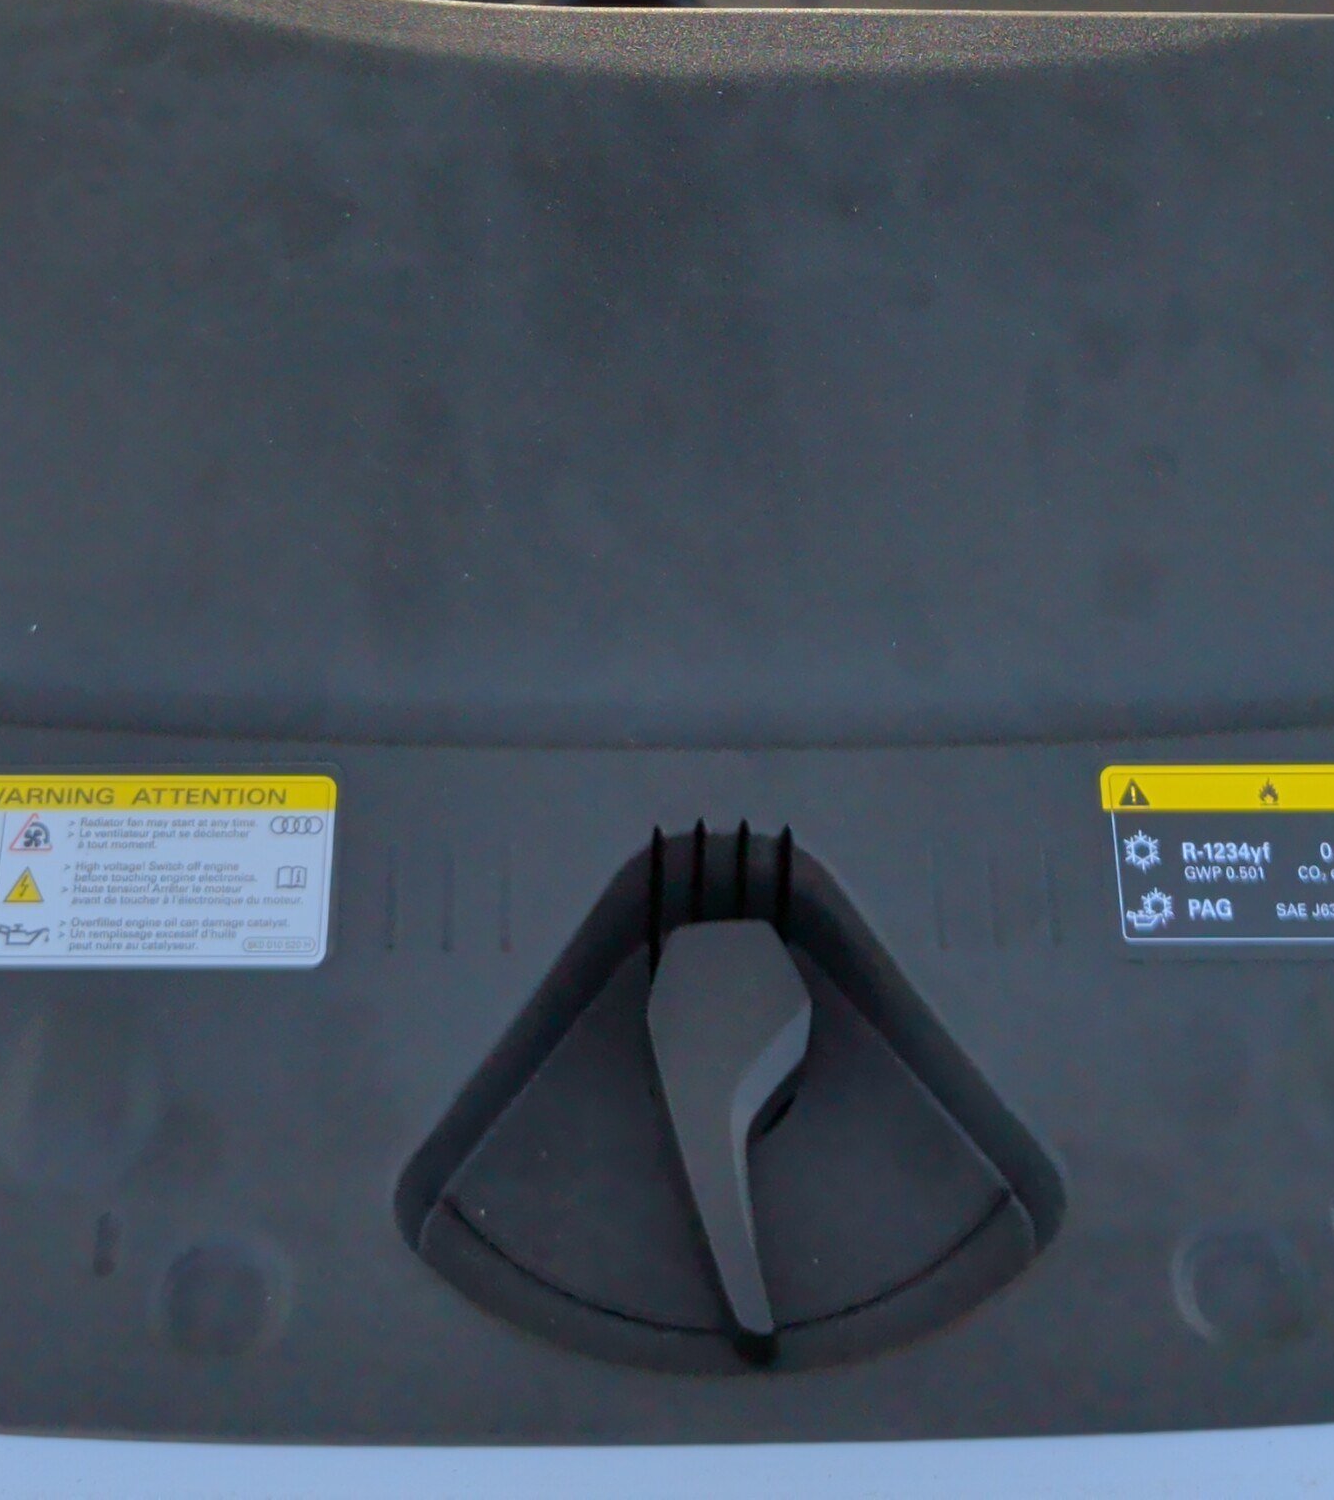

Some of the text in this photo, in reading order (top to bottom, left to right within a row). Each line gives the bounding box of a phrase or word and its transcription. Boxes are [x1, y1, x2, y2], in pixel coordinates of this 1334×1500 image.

[132, 787, 287, 805] ATTENTION
[80, 818, 124, 827] Radiator
[127, 818, 143, 827] fan
[147, 819, 167, 829] may
[172, 818, 195, 827] start
[198, 818, 207, 827] at
[210, 819, 229, 829] any
[79, 829, 92, 838] Le
[95, 829, 149, 838] ventilateur
[153, 830, 176, 840] peut
[87, 840, 108, 849] tout
[1182, 842, 1271, 863] R-1234yf
[76, 861, 239, 873] High voltage! Switch off engine
[75, 873, 108, 882] before
[111, 873, 157, 883] touching
[160, 874, 195, 883] engine
[1185, 865, 1265, 881] GWP 0.501
[74, 884, 104, 893] Haute
[107, 884, 150, 893] tension!
[192, 884, 201, 893] le
[204, 885, 242, 893] moteur
[72, 896, 100, 904] avant
[104, 895, 117, 904] de
[120, 895, 160, 904] toucher
[246, 895, 260, 904] du
[1188, 898, 1233, 920] PAG
[1276, 903, 1308, 919] SAE
[71, 918, 122, 927] Overfilled
[125, 919, 161, 929] engine
[165, 918, 178, 927] oil
[201, 918, 244, 929] damage
[70, 929, 85, 938] Un
[89, 929, 153, 941] remplissage
[156, 929, 198, 938] excessif
[68, 941, 92, 952] peut
[96, 941, 122, 950] nuire
[125, 942, 138, 950] au
